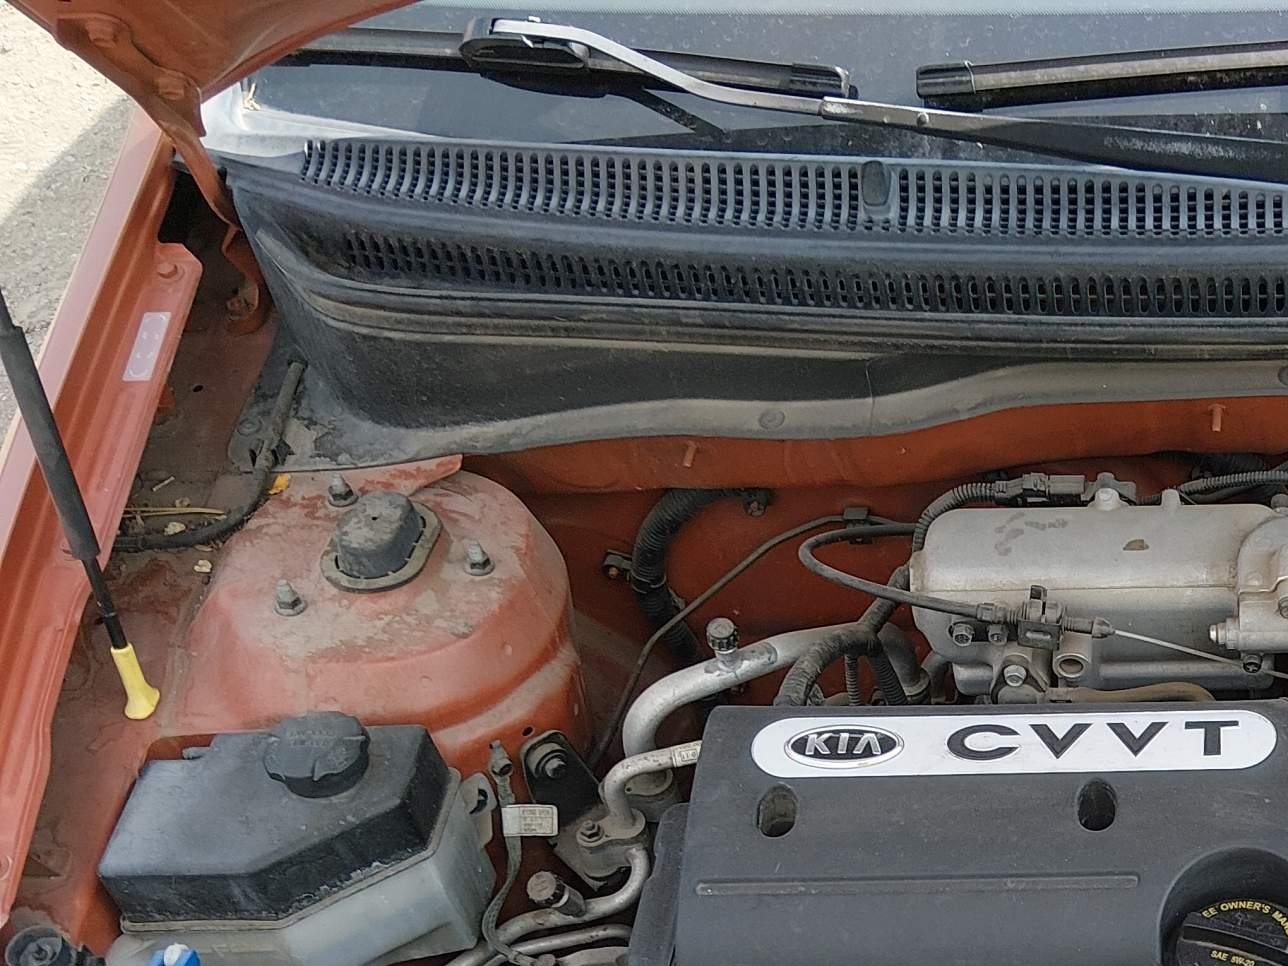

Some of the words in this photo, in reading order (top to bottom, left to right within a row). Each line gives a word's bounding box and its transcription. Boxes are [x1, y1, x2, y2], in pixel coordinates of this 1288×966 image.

[804, 731, 882, 755] KIA
[946, 720, 1240, 761] CVVT
[1201, 906, 1219, 919] EE
[1219, 900, 1271, 914] OWNER'S
[1210, 950, 1229, 961] SAE
